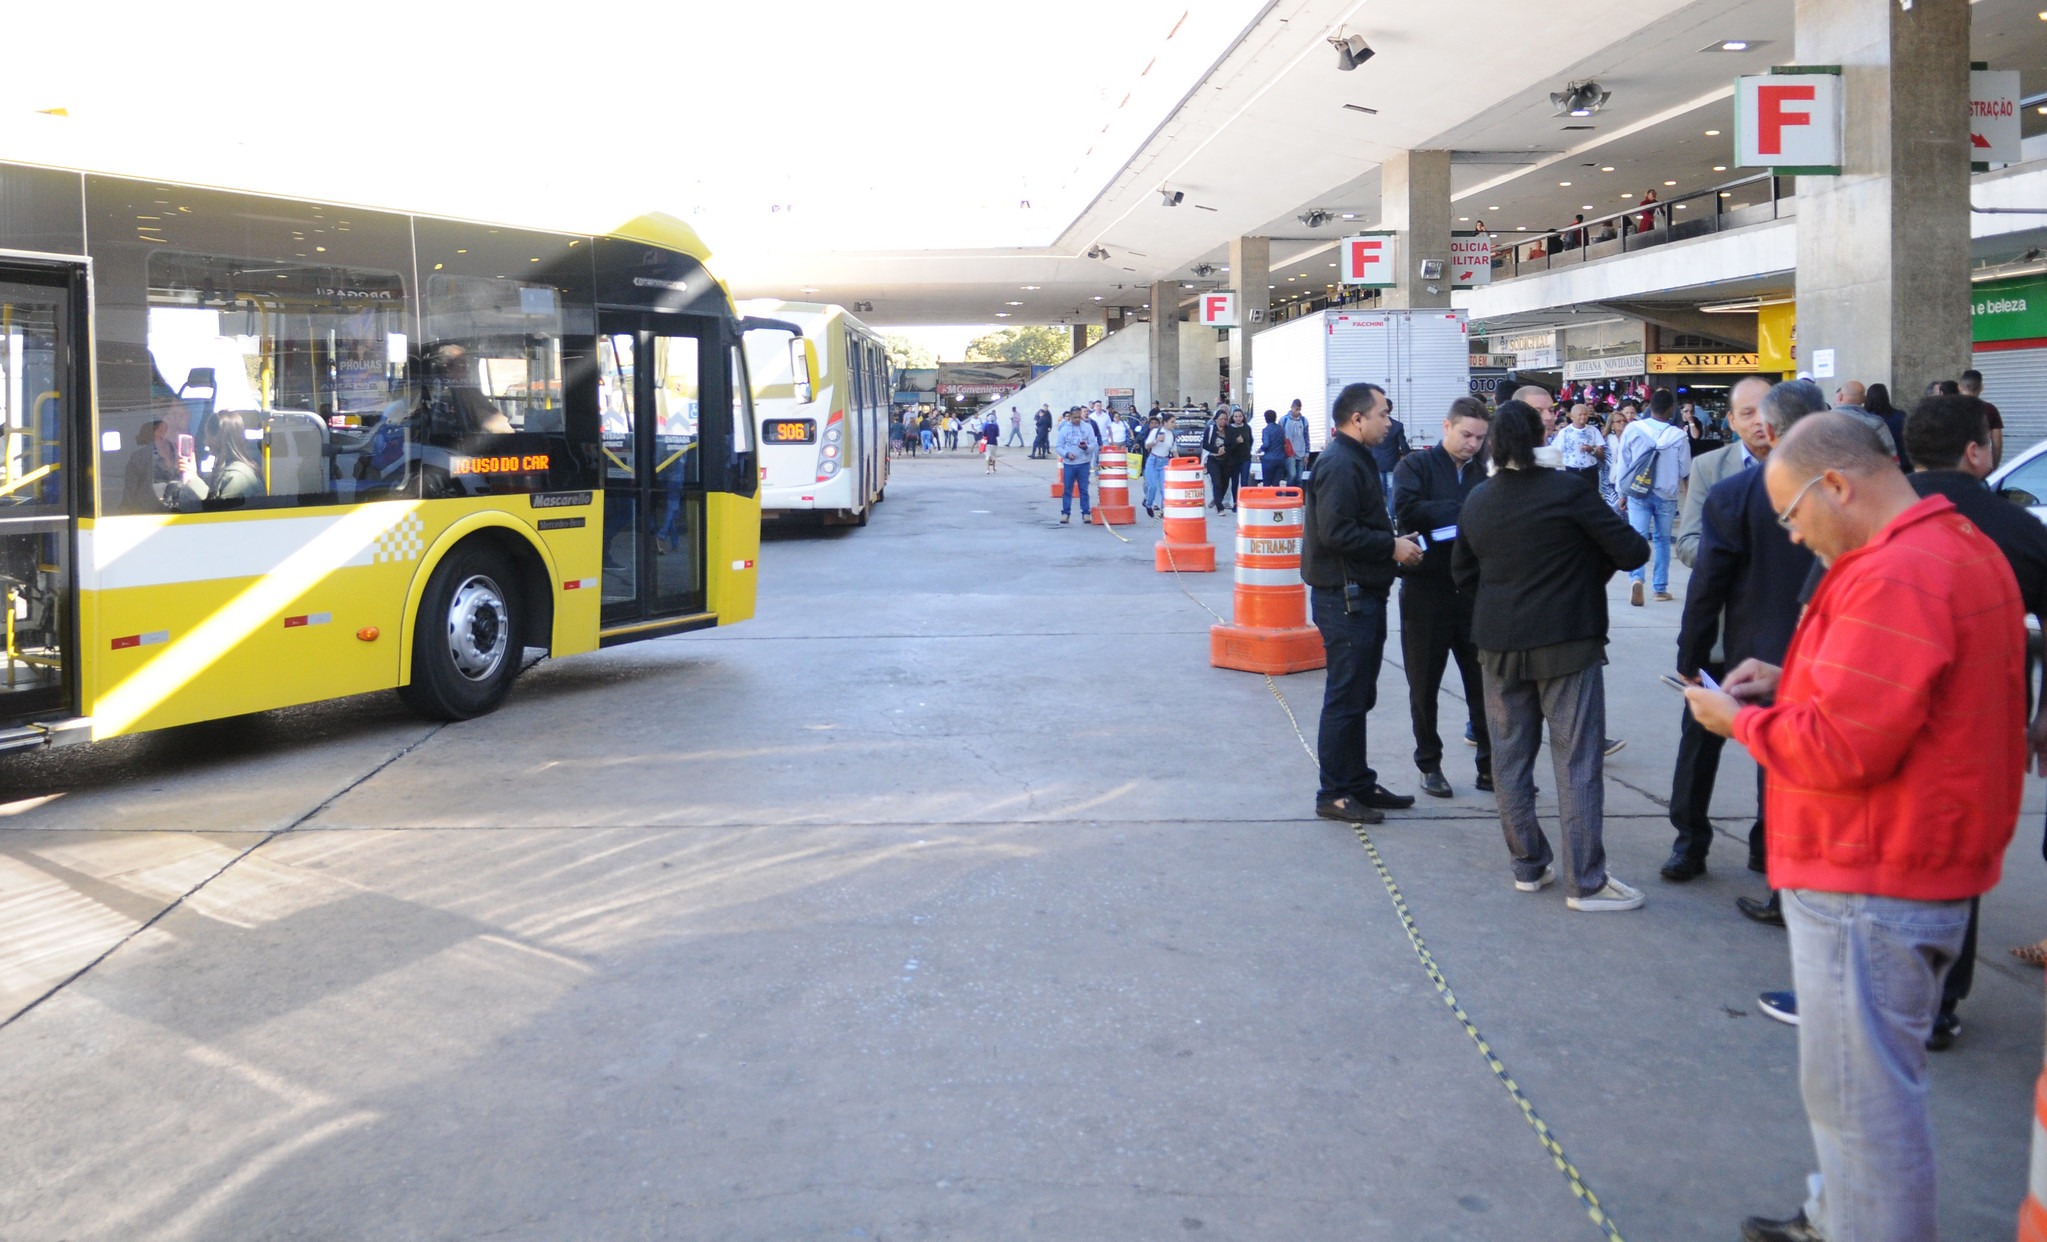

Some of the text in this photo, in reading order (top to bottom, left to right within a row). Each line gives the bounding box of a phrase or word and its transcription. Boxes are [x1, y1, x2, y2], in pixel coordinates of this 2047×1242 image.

[1758, 85, 1815, 154] F
[1352, 241, 1382, 278] F
[1451, 255, 1489, 265] ILITAR
[1207, 296, 1227, 321] F
[1977, 303, 1985, 314] e
[1986, 298, 2027, 314] beleza
[1478, 355, 1488, 365] EM
[1493, 354, 1517, 366] MINUTO
[1603, 355, 1644, 369] NOVIDADES
[777, 423, 805, 440] 906
[471, 457, 499, 474] USO
[500, 456, 519, 472] DO
[522, 455, 550, 470] CAR
[533, 492, 591, 508] Mascarello
[1250, 539, 1296, 554] DETRAN-DF
